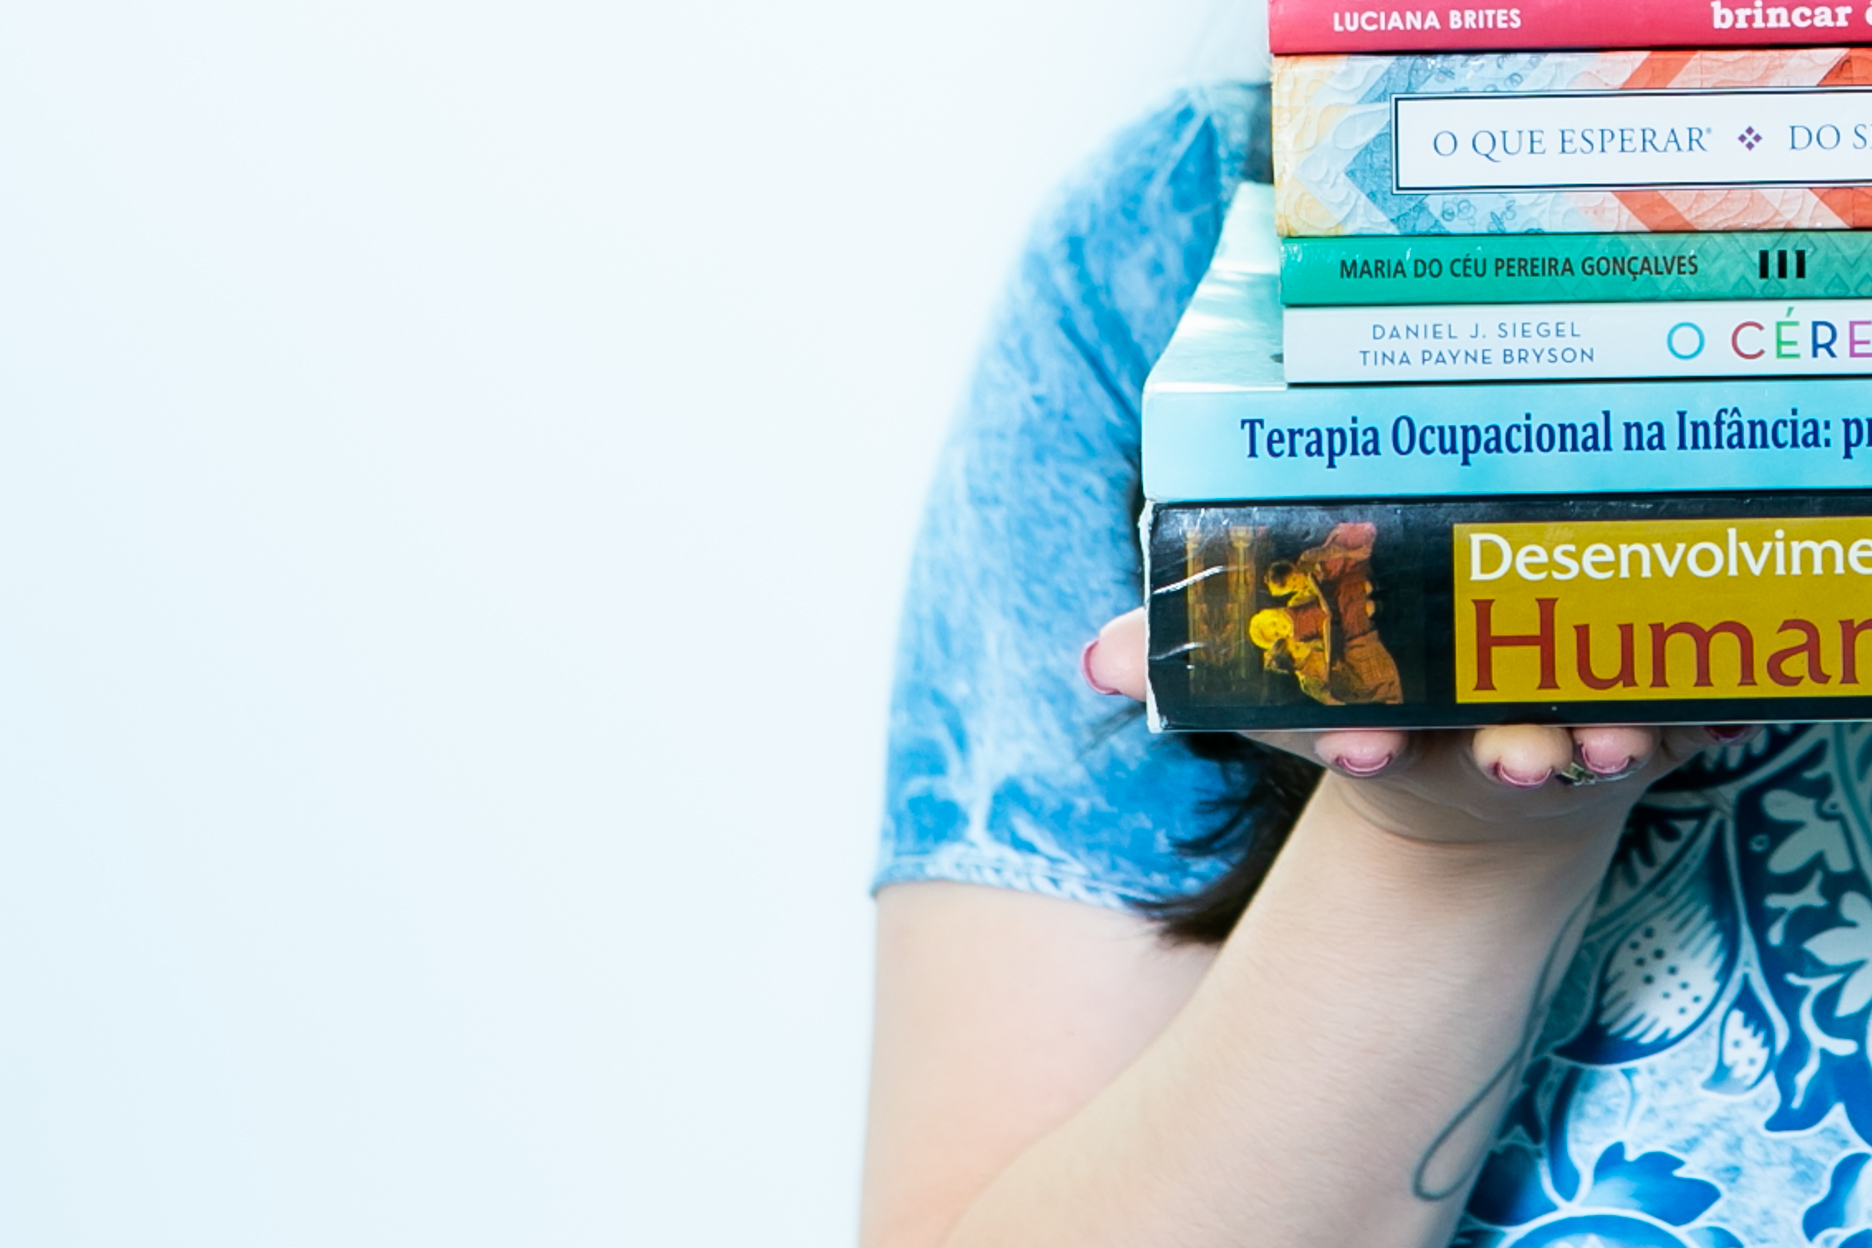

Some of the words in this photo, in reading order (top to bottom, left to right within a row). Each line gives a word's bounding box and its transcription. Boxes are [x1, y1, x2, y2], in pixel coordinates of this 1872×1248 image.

[1333, 9, 1441, 32] LUCIANA
[1449, 8, 1523, 29] BRITES
[1432, 129, 1458, 157] O
[1471, 128, 1546, 163] QUE
[1558, 126, 1708, 156] ESPERAR
[1788, 123, 1843, 151] DO
[1339, 258, 1407, 280] MARIA
[1413, 258, 1443, 279] DO
[1450, 252, 1488, 278] CÉU
[1495, 257, 1574, 278] PEREIRA
[1581, 255, 1699, 282] GONÇALVES
[1372, 323, 1459, 341] DANIEL
[1467, 323, 1488, 340] J.
[1497, 321, 1581, 339] SIEGEL
[1666, 322, 1705, 360] O
[1359, 349, 1414, 367] TINA
[1421, 349, 1494, 366] PAYNE
[1503, 347, 1595, 365] BRYSON
[1240, 416, 1382, 469] Terapia
[1391, 409, 1613, 467] Ocupacional
[1622, 416, 1665, 453] na
[1676, 406, 1833, 451] Infância:
